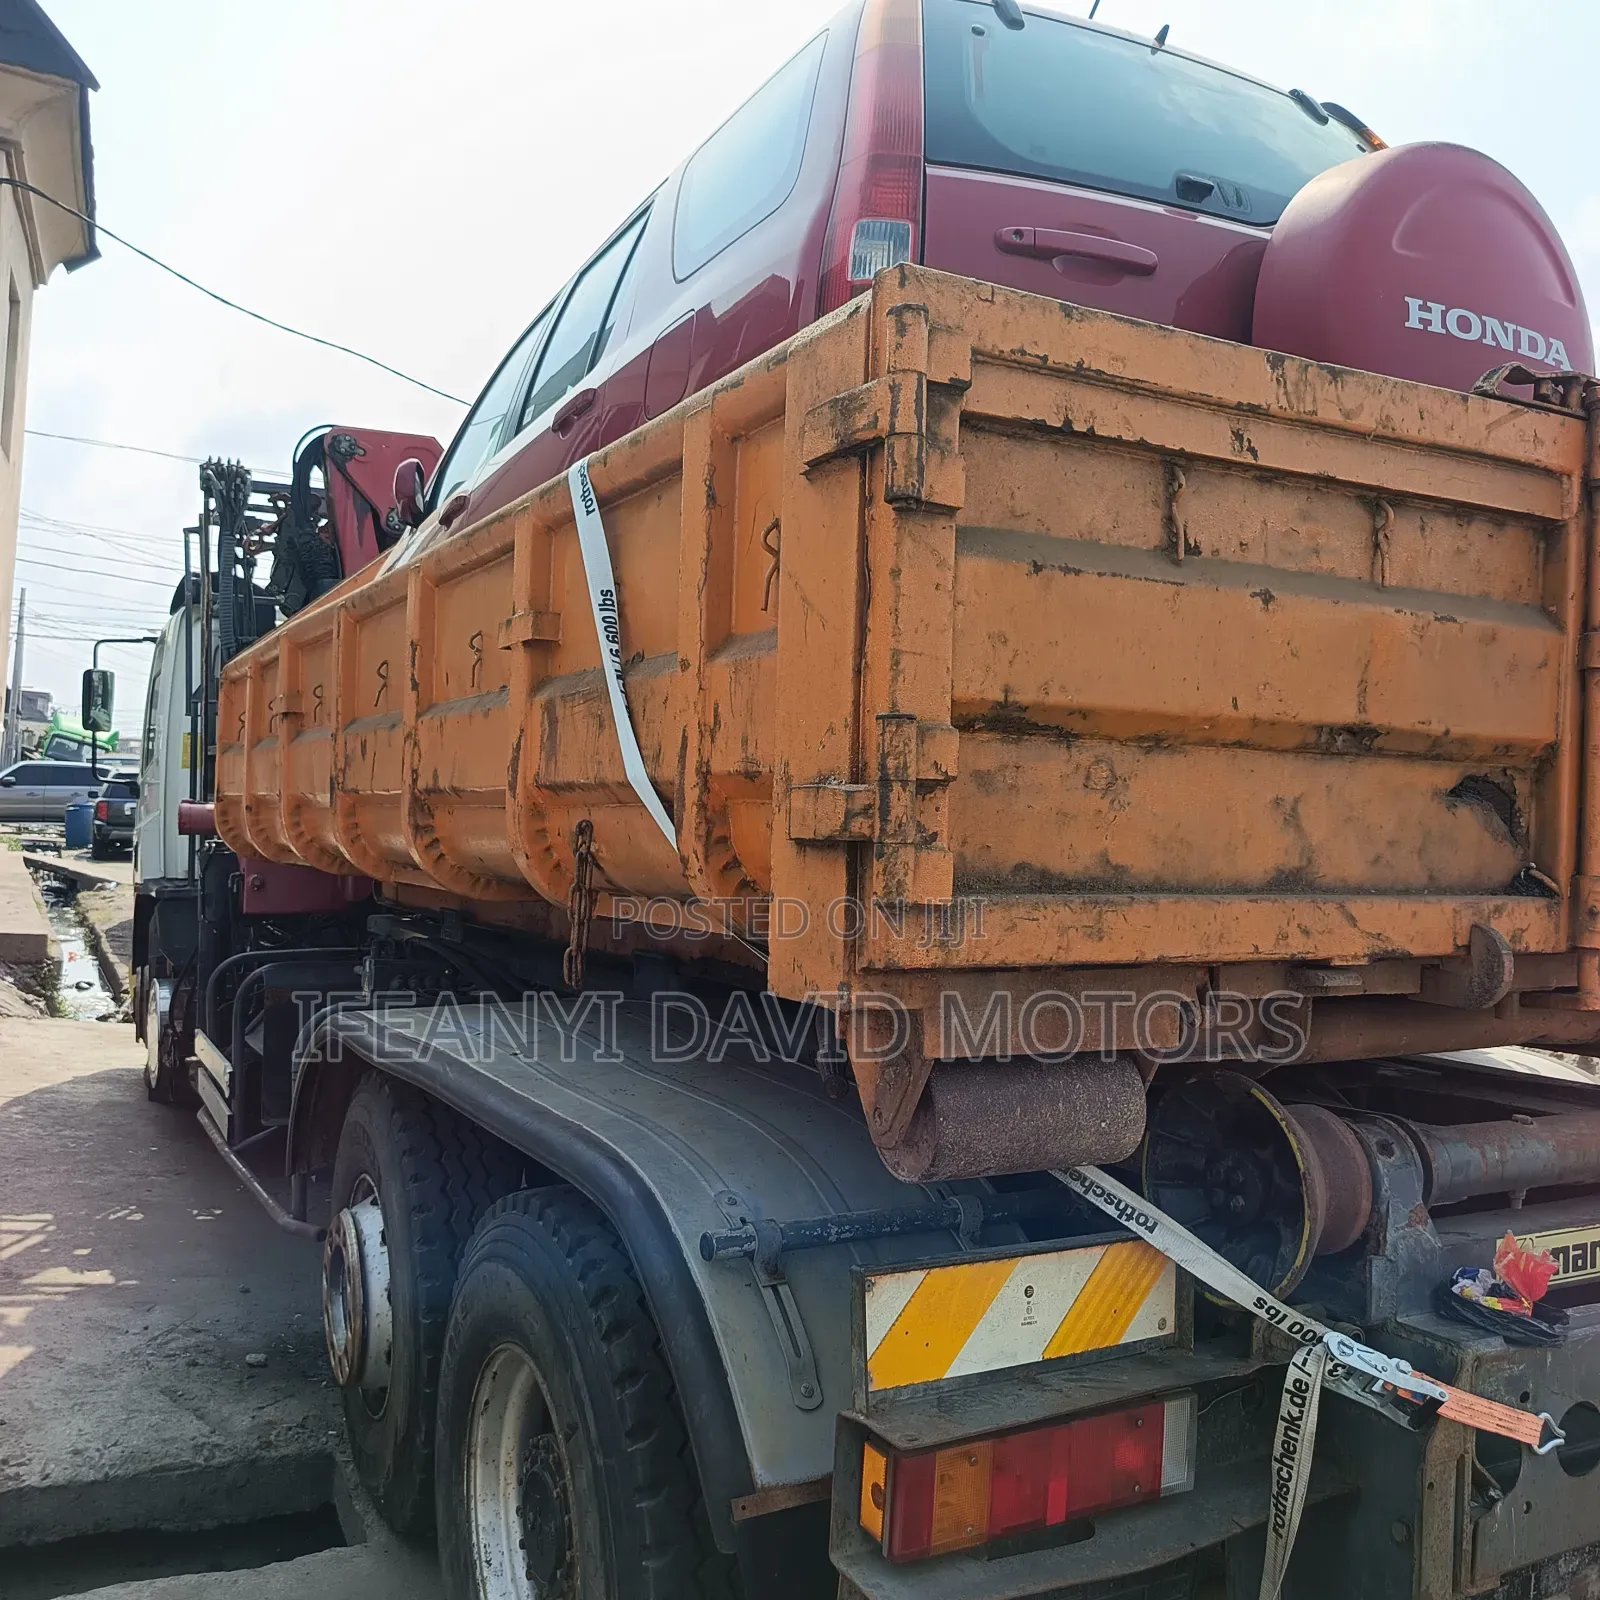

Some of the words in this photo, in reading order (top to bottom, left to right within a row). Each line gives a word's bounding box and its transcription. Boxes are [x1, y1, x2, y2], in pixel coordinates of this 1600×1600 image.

[1404, 296, 1573, 371] HONDA
[597, 589, 617, 613] lbs
[1252, 1296, 1289, 1326] lbs
[1271, 1377, 1310, 1540] rothschenk.de
